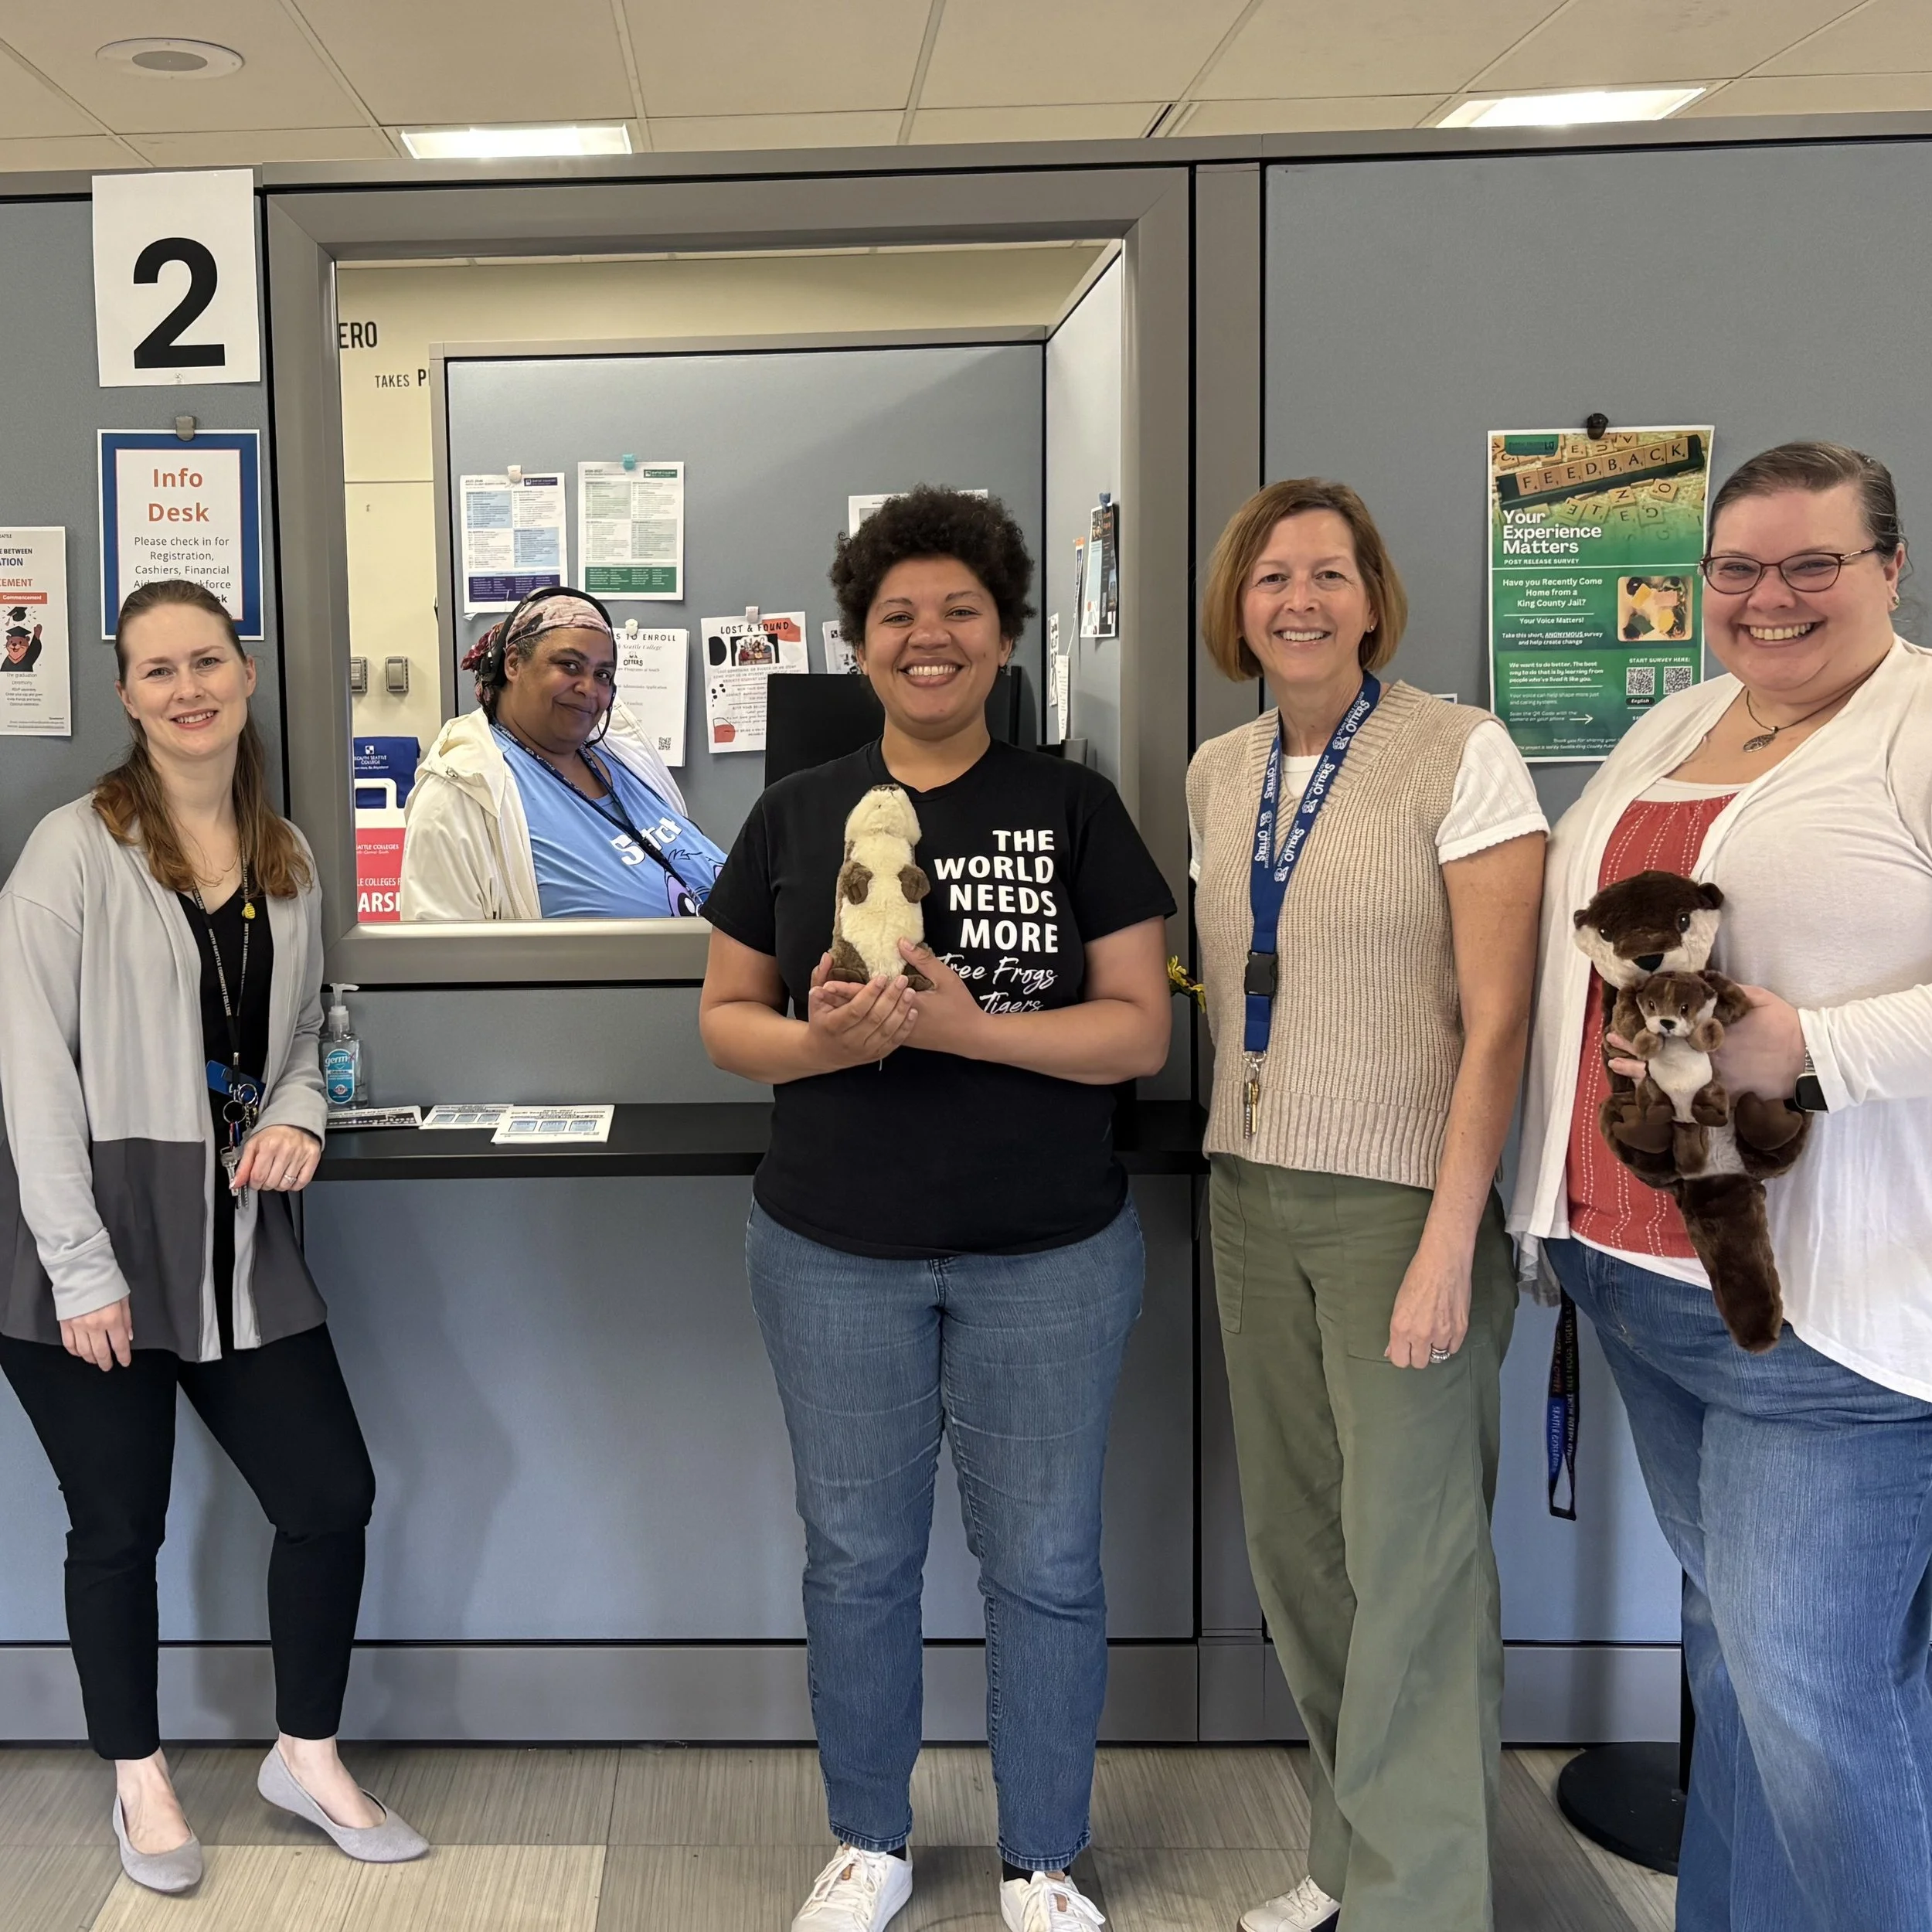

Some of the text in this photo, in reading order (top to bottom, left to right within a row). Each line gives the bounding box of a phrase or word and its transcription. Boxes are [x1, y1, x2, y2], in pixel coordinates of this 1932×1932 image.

[133, 236, 226, 369] 2
[339, 321, 377, 349] ERO
[375, 369, 430, 388] TAKES P
[1523, 444, 1682, 488] FEEDBACK
[153, 468, 203, 488] Info
[148, 502, 209, 522] Desk
[1503, 510, 1546, 524] Your
[134, 536, 230, 546] Please check in for
[1503, 524, 1602, 541] Experience
[150, 551, 214, 562] Registration,
[1503, 540, 1579, 555] Matters
[135, 566, 230, 576] Cashiers, Financial
[1543, 578, 1577, 587] Recently
[1517, 598, 1586, 609] King County Jail?
[721, 625, 743, 634] LOST
[758, 622, 788, 631] FOUND
[1345, 699, 1370, 733] OTTERS
[1264, 767, 1275, 799] OTTERS
[1314, 764, 1335, 795] OTTERS
[992, 829, 1055, 852] THE
[1254, 830, 1268, 862] OTTERS
[1284, 828, 1305, 862] OTTERS
[934, 855, 1054, 884] WORLD
[365, 878, 396, 886] COLLEGES
[950, 884, 1057, 917] NEEDS
[960, 918, 1058, 953] MORE
[934, 952, 1058, 995] Tree Frogs
[979, 991, 1043, 1014] Tigers
